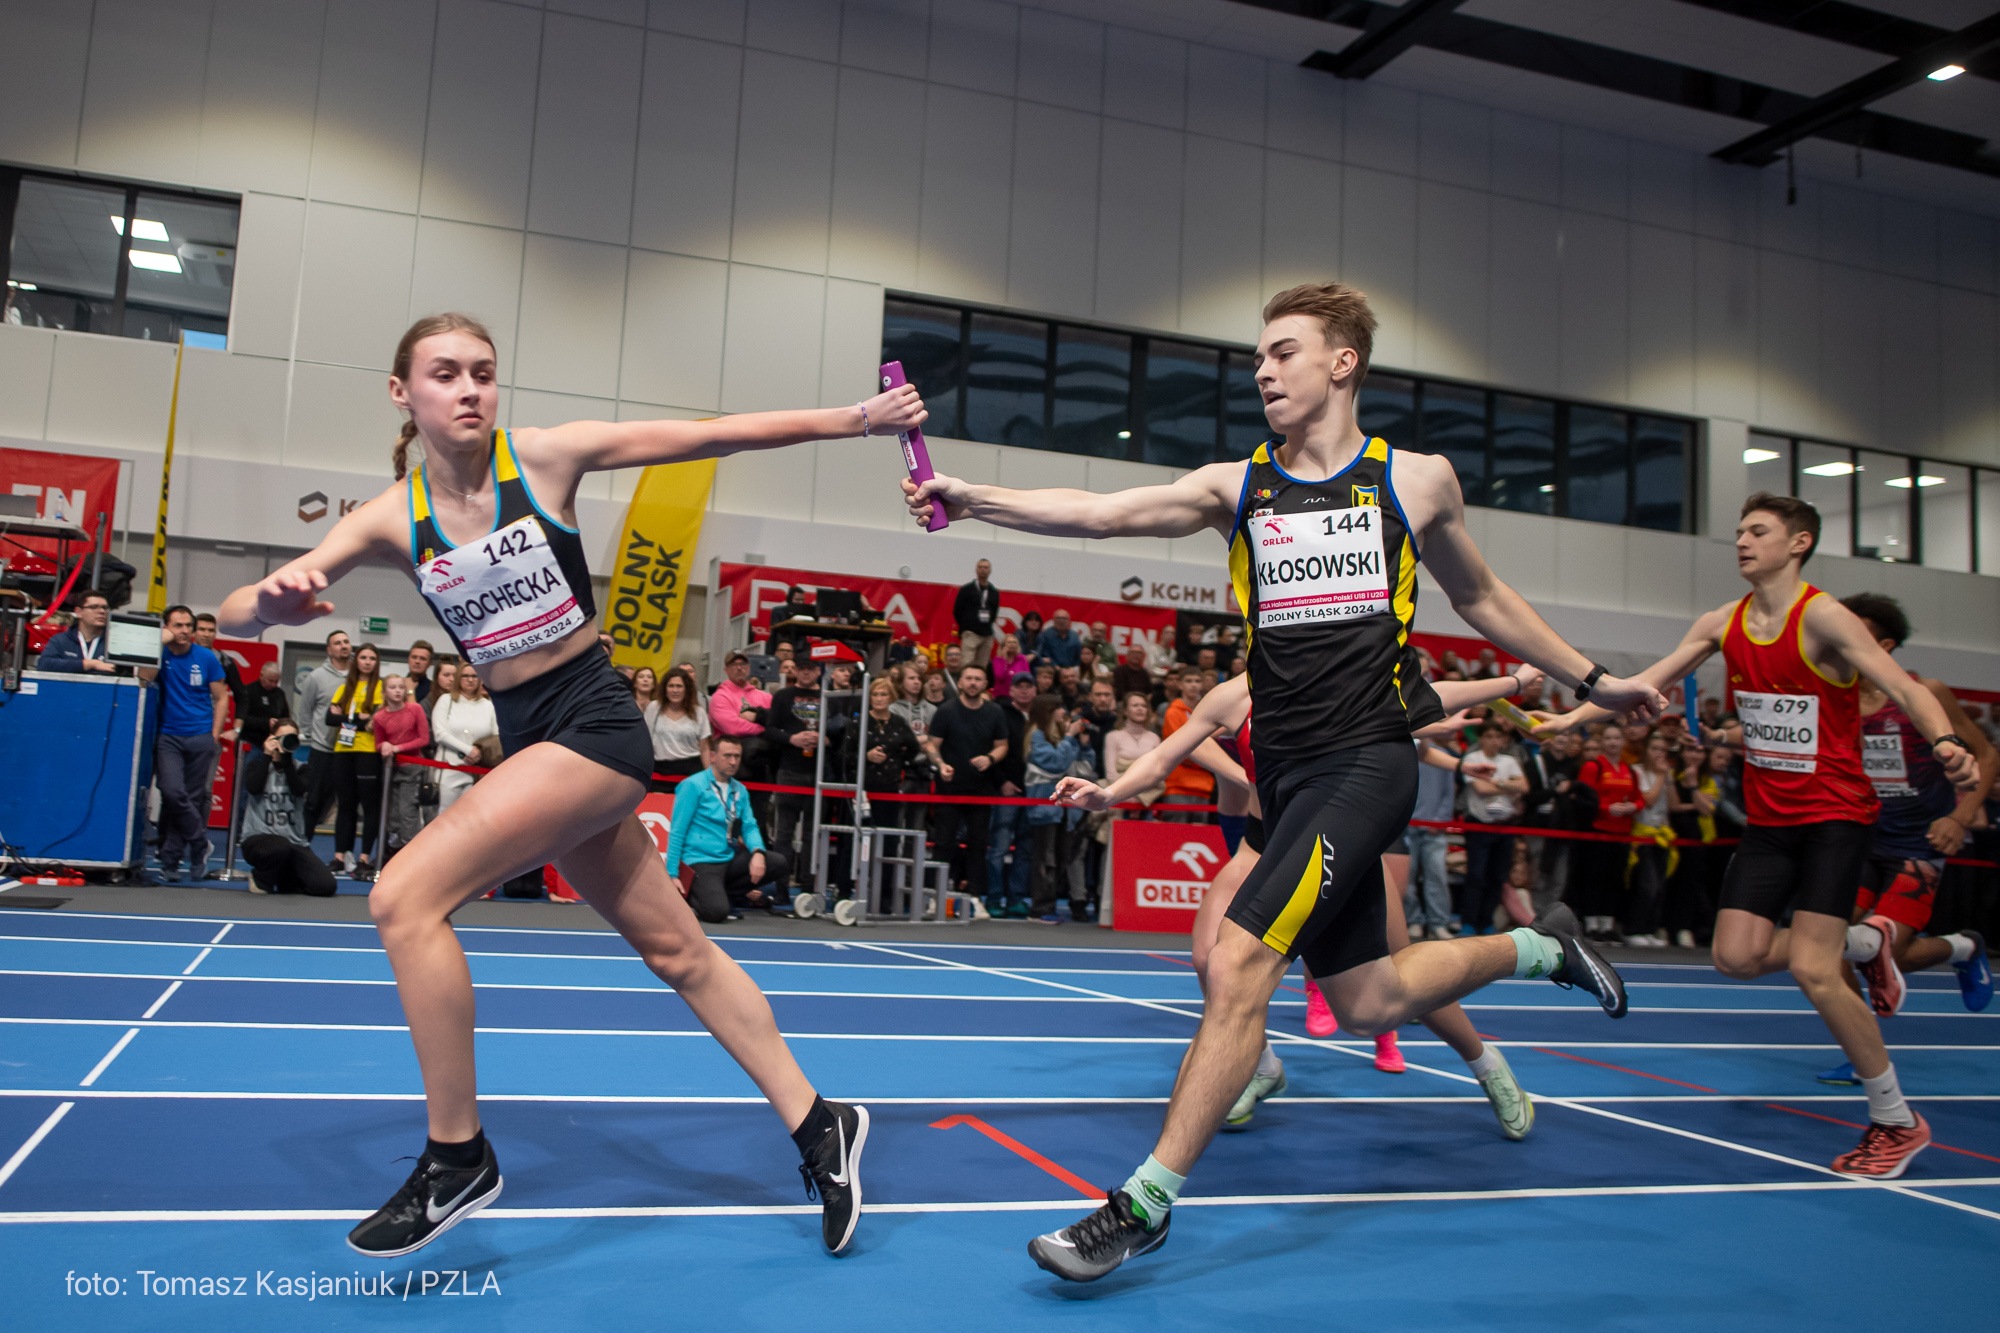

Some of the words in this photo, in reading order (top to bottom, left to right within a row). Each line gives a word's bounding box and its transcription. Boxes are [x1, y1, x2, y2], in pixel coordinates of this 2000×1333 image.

[1322, 512, 1370, 535] 144
[483, 528, 532, 566] 142
[1262, 536, 1293, 546] ORLEN
[1258, 551, 1380, 586] KŁOSOWSKI
[436, 576, 466, 593] ORLEN
[610, 528, 655, 647] DOLNY
[1152, 582, 1215, 604] KGHM
[443, 567, 561, 627] GROCHECKA
[630, 544, 683, 654] ŚLĄSK
[1271, 600, 1292, 608] Halowe
[1293, 596, 1332, 605] Mistrzostwa
[1333, 594, 1353, 602] Polski
[1354, 592, 1366, 600] U18
[1370, 591, 1384, 599] U20
[1267, 611, 1302, 623] DOLNY
[1305, 607, 1341, 618] ŚLĄSK
[1344, 604, 1374, 614] 2024
[477, 645, 507, 660] DOLNY
[509, 633, 542, 651] ŚLĄSK
[544, 617, 572, 638] 2024
[1774, 699, 1808, 714] 679
